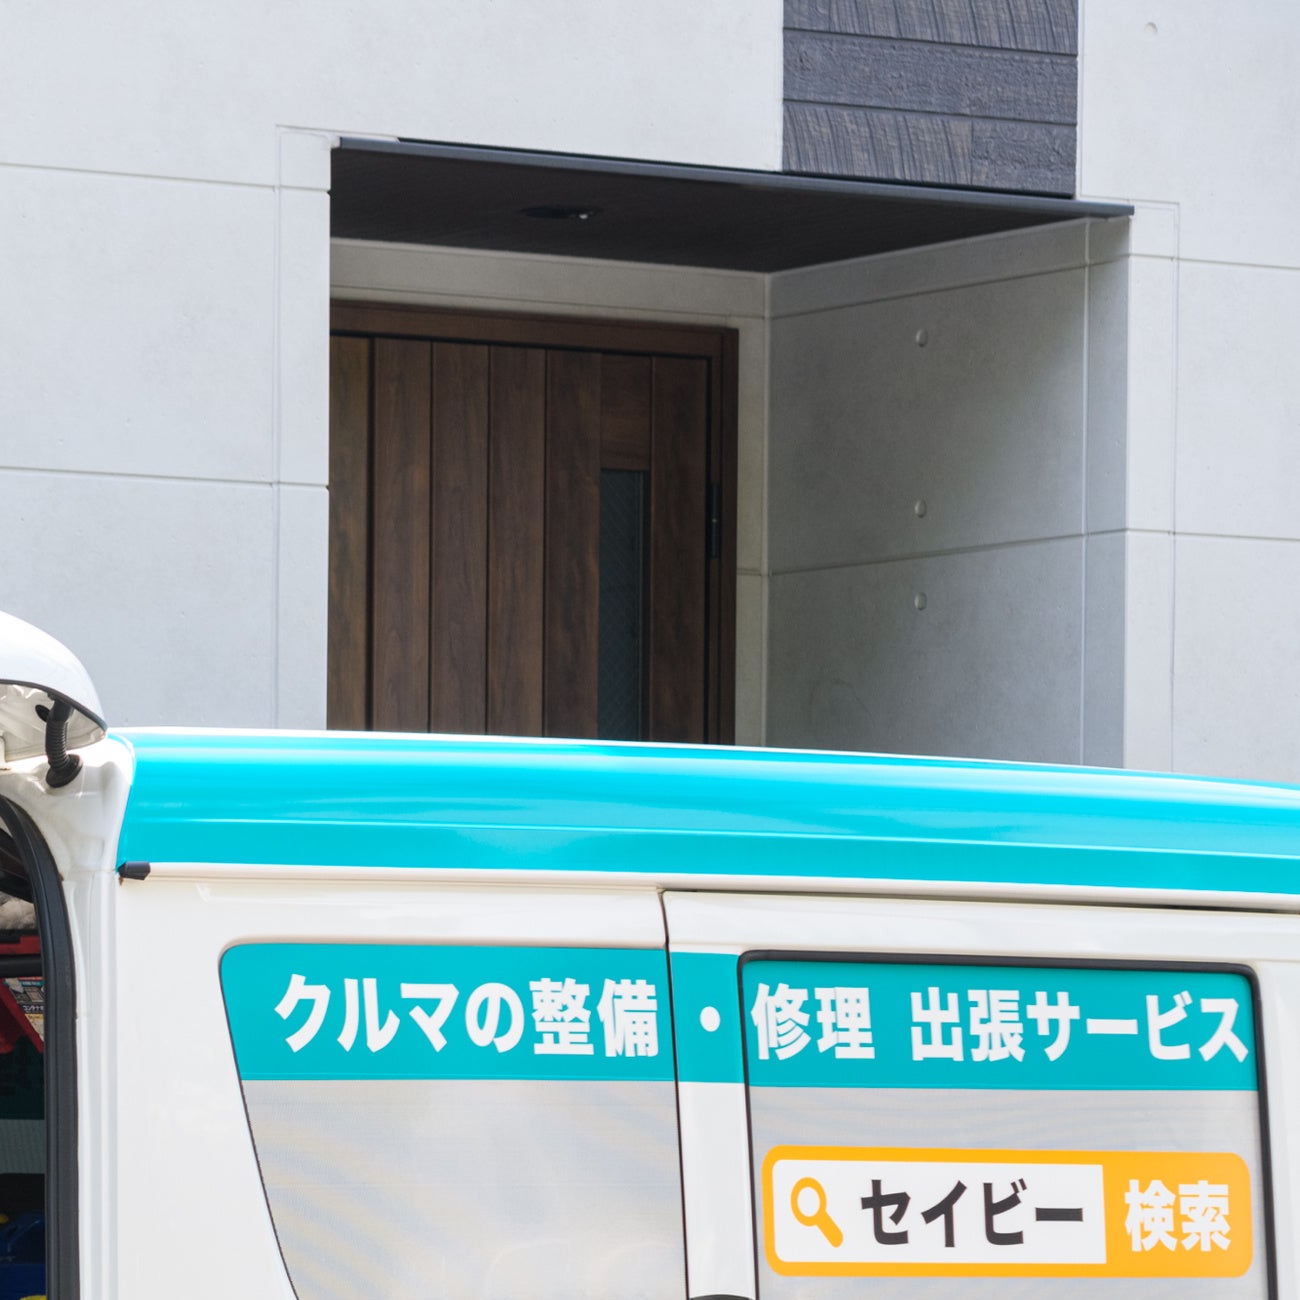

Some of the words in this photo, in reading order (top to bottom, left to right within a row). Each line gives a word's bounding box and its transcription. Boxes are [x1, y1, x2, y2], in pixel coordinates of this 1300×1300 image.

[910, 986, 1249, 1063] 出張サービス
[860, 1178, 1084, 1248] セイビー
[1124, 1179, 1232, 1252] 検索
